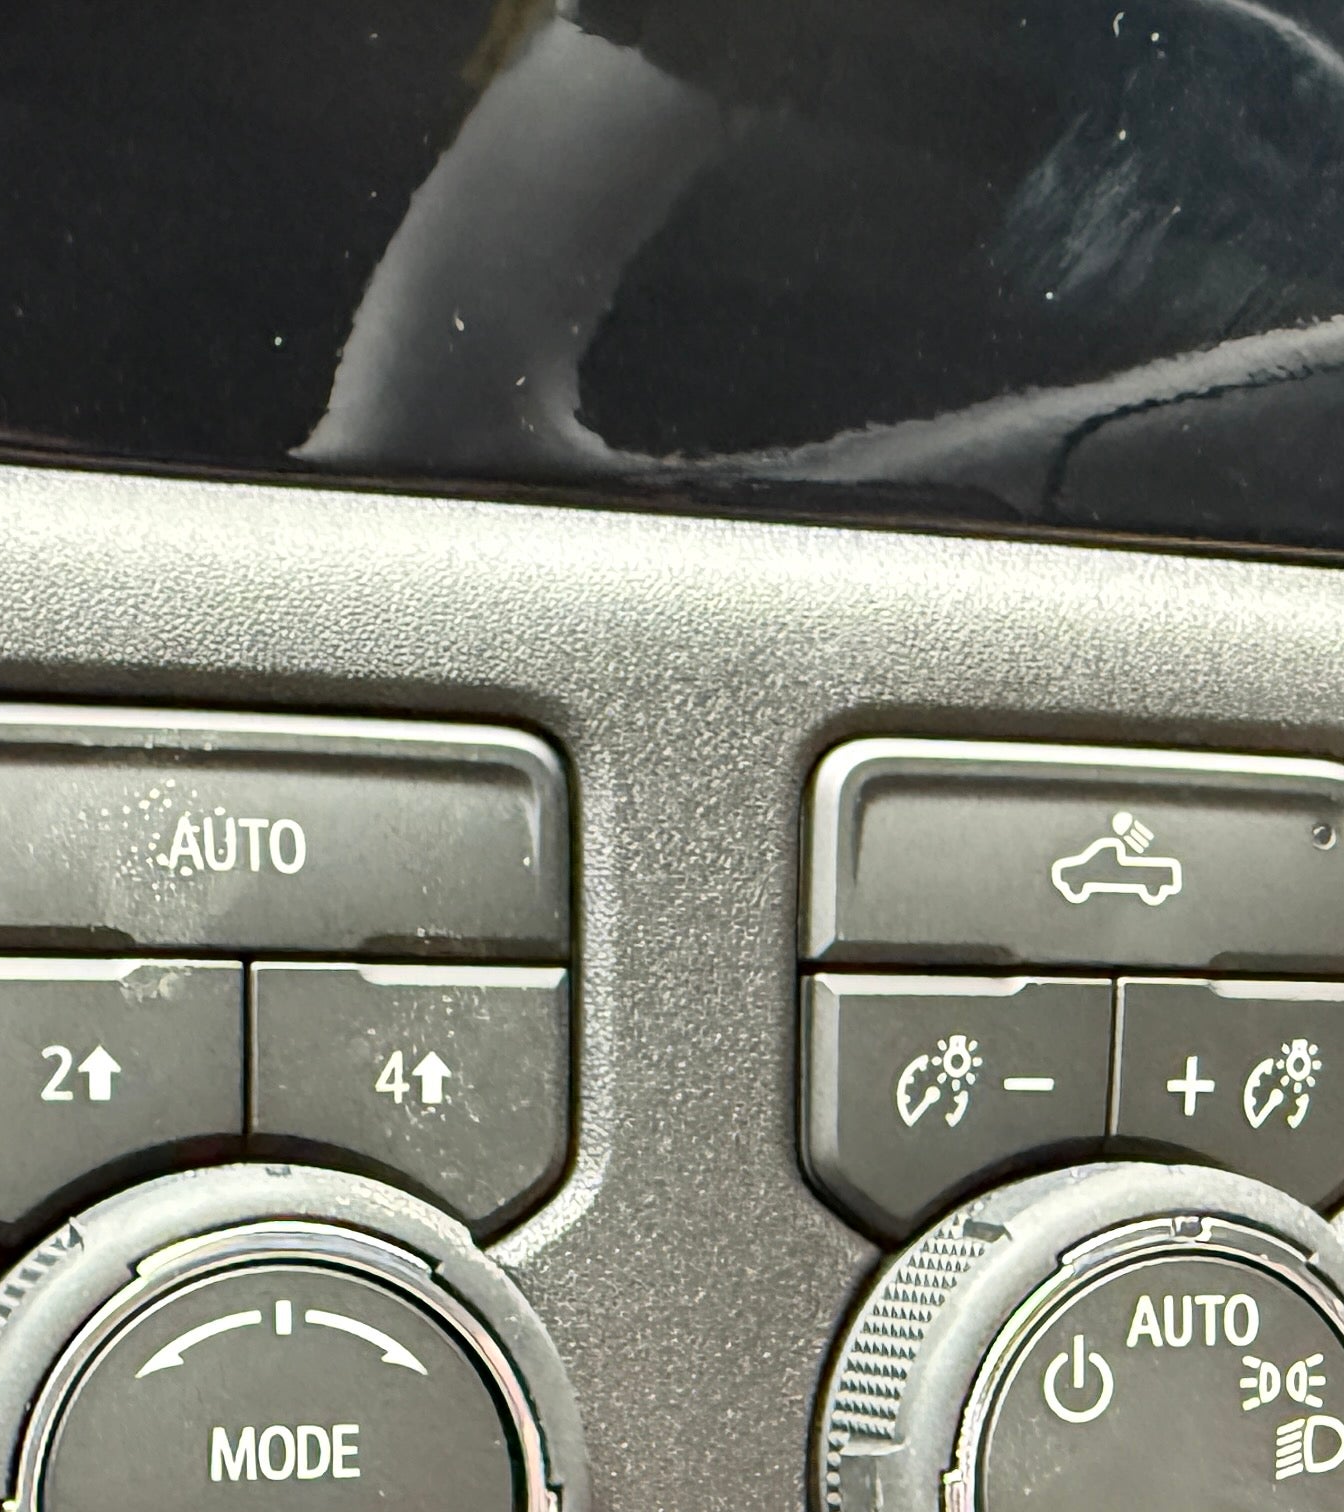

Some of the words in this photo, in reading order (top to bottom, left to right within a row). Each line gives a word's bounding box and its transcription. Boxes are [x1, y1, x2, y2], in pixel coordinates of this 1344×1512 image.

[166, 818, 307, 874] AUTO
[41, 1045, 73, 1101] 2
[375, 1051, 409, 1104] 4
[1127, 1294, 1259, 1347] AUTO
[210, 1425, 360, 1481] MODE
